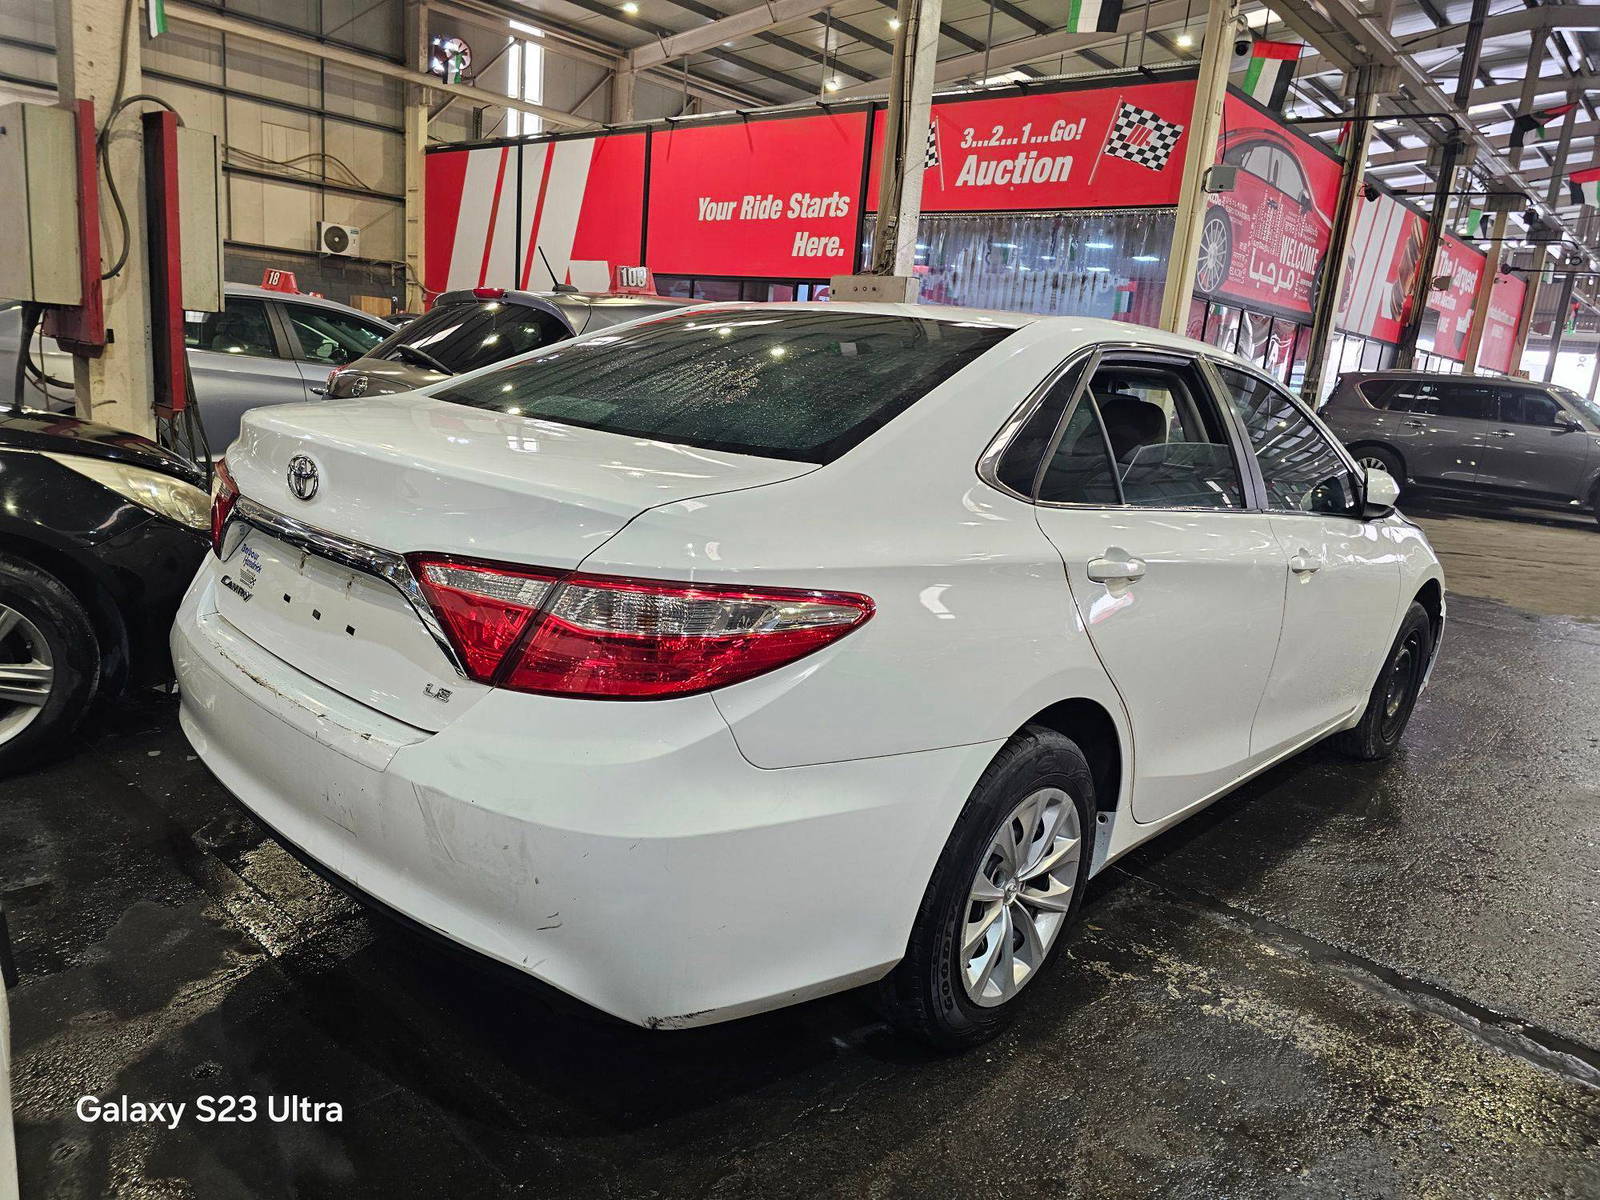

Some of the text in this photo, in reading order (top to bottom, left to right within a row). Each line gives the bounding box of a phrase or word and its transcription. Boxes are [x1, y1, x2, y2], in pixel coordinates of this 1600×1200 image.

[955, 151, 1073, 188] Auction
[697, 191, 850, 222] Your Ride Starts
[791, 231, 845, 257] Here.
[1280, 235, 1320, 276] WELCOME
[268, 271, 281, 286] 18
[1249, 247, 1295, 294] مرحبا
[422, 682, 453, 704] LE
